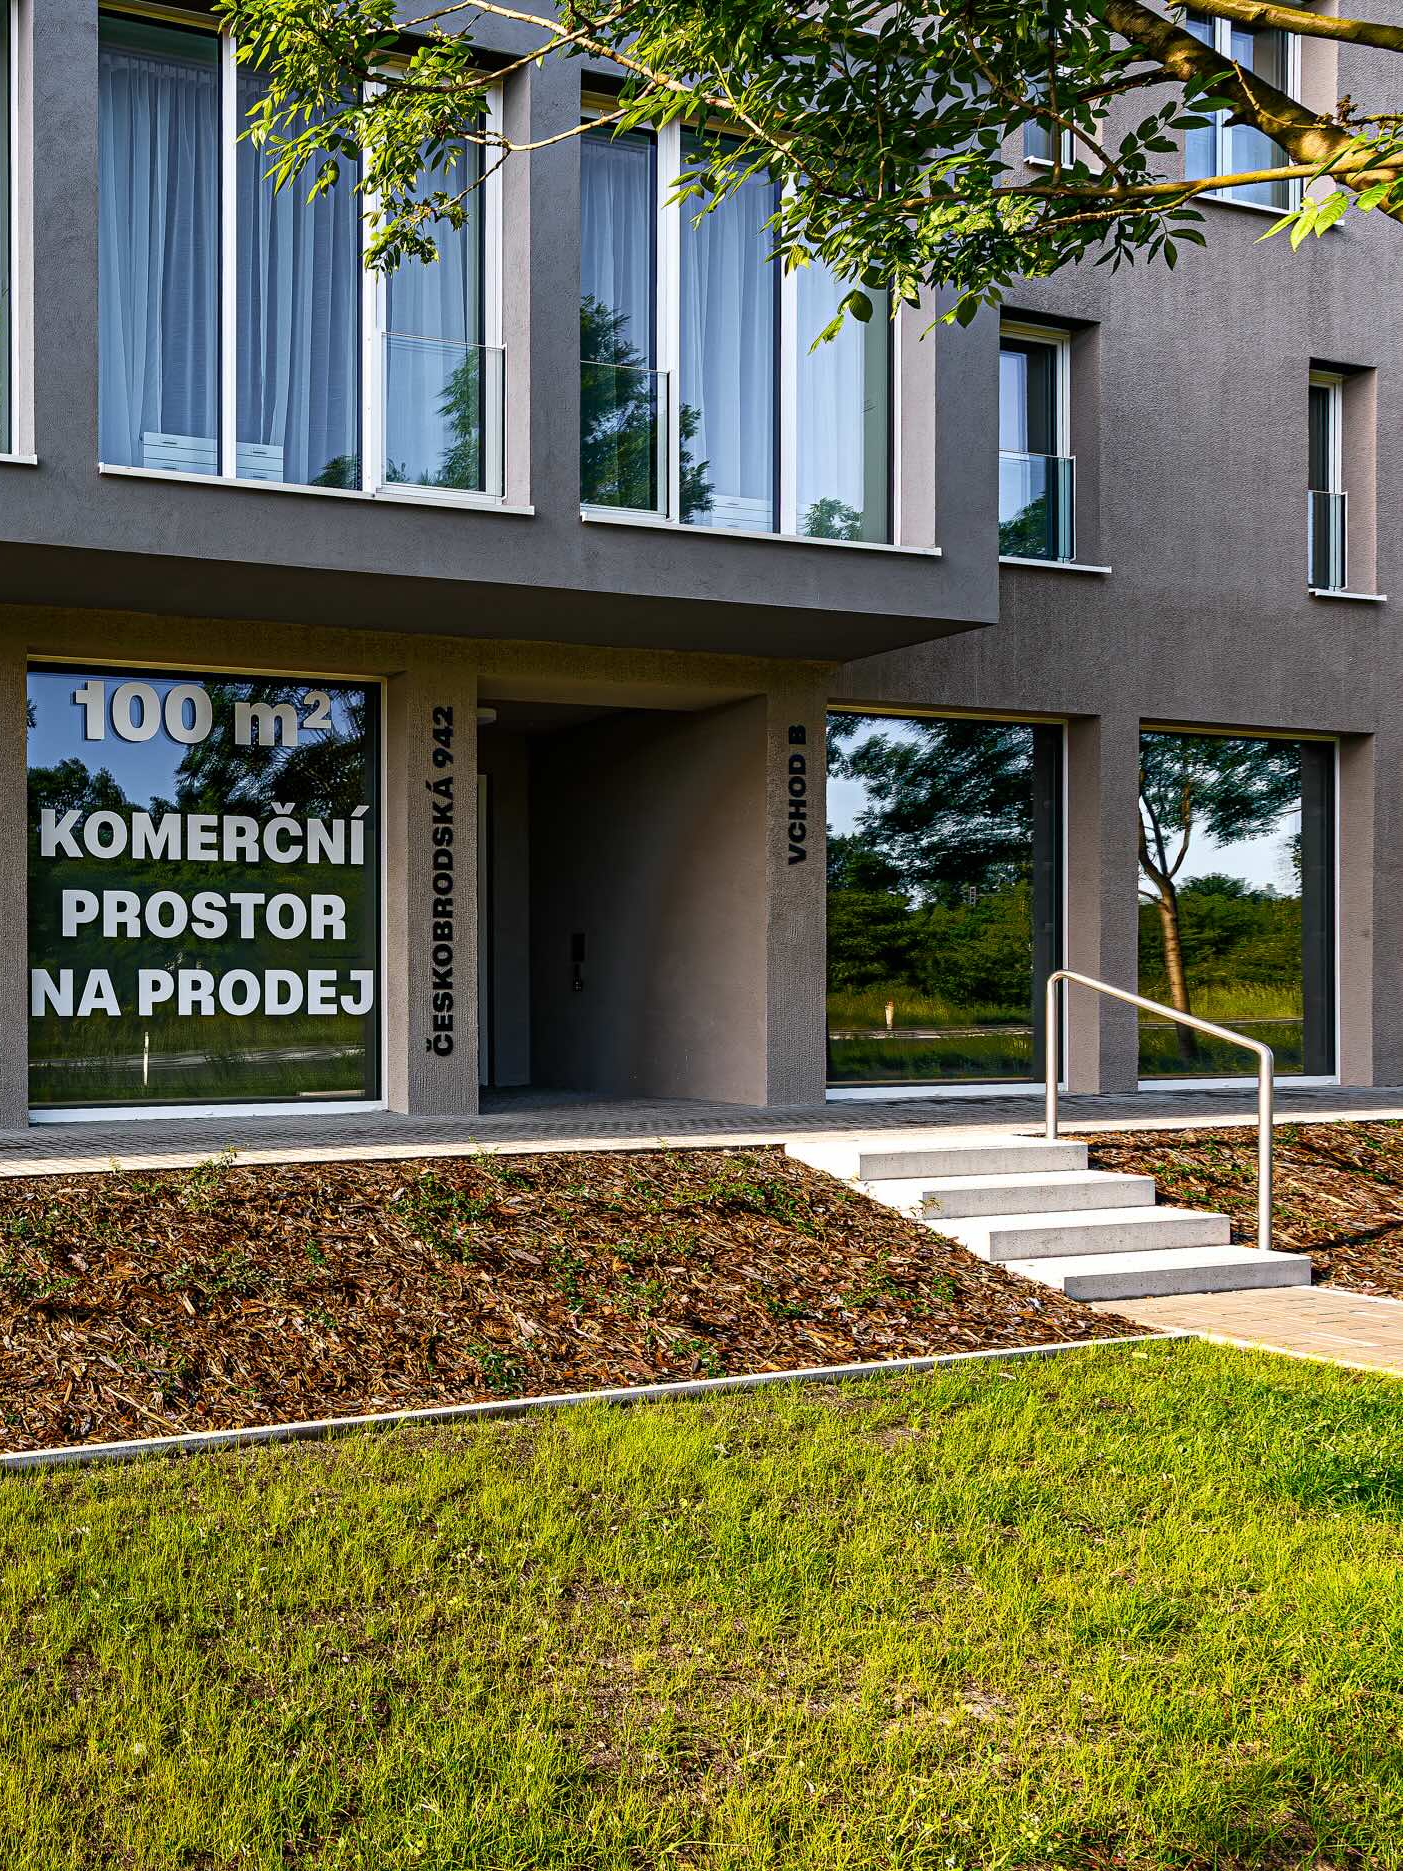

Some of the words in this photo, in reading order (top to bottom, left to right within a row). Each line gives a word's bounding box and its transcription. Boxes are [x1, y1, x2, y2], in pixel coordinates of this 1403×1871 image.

[75, 680, 214, 745] 100
[432, 706, 453, 768] 942
[788, 724, 806, 745] B
[40, 802, 370, 865] KOMERČNÍ
[788, 754, 806, 865] VCHOD
[62, 890, 346, 940] PROSTOR
[426, 776, 453, 1057] ČESKOBRODSKÁ
[31, 968, 121, 1017] NA
[138, 968, 374, 1016] PRODEJ
